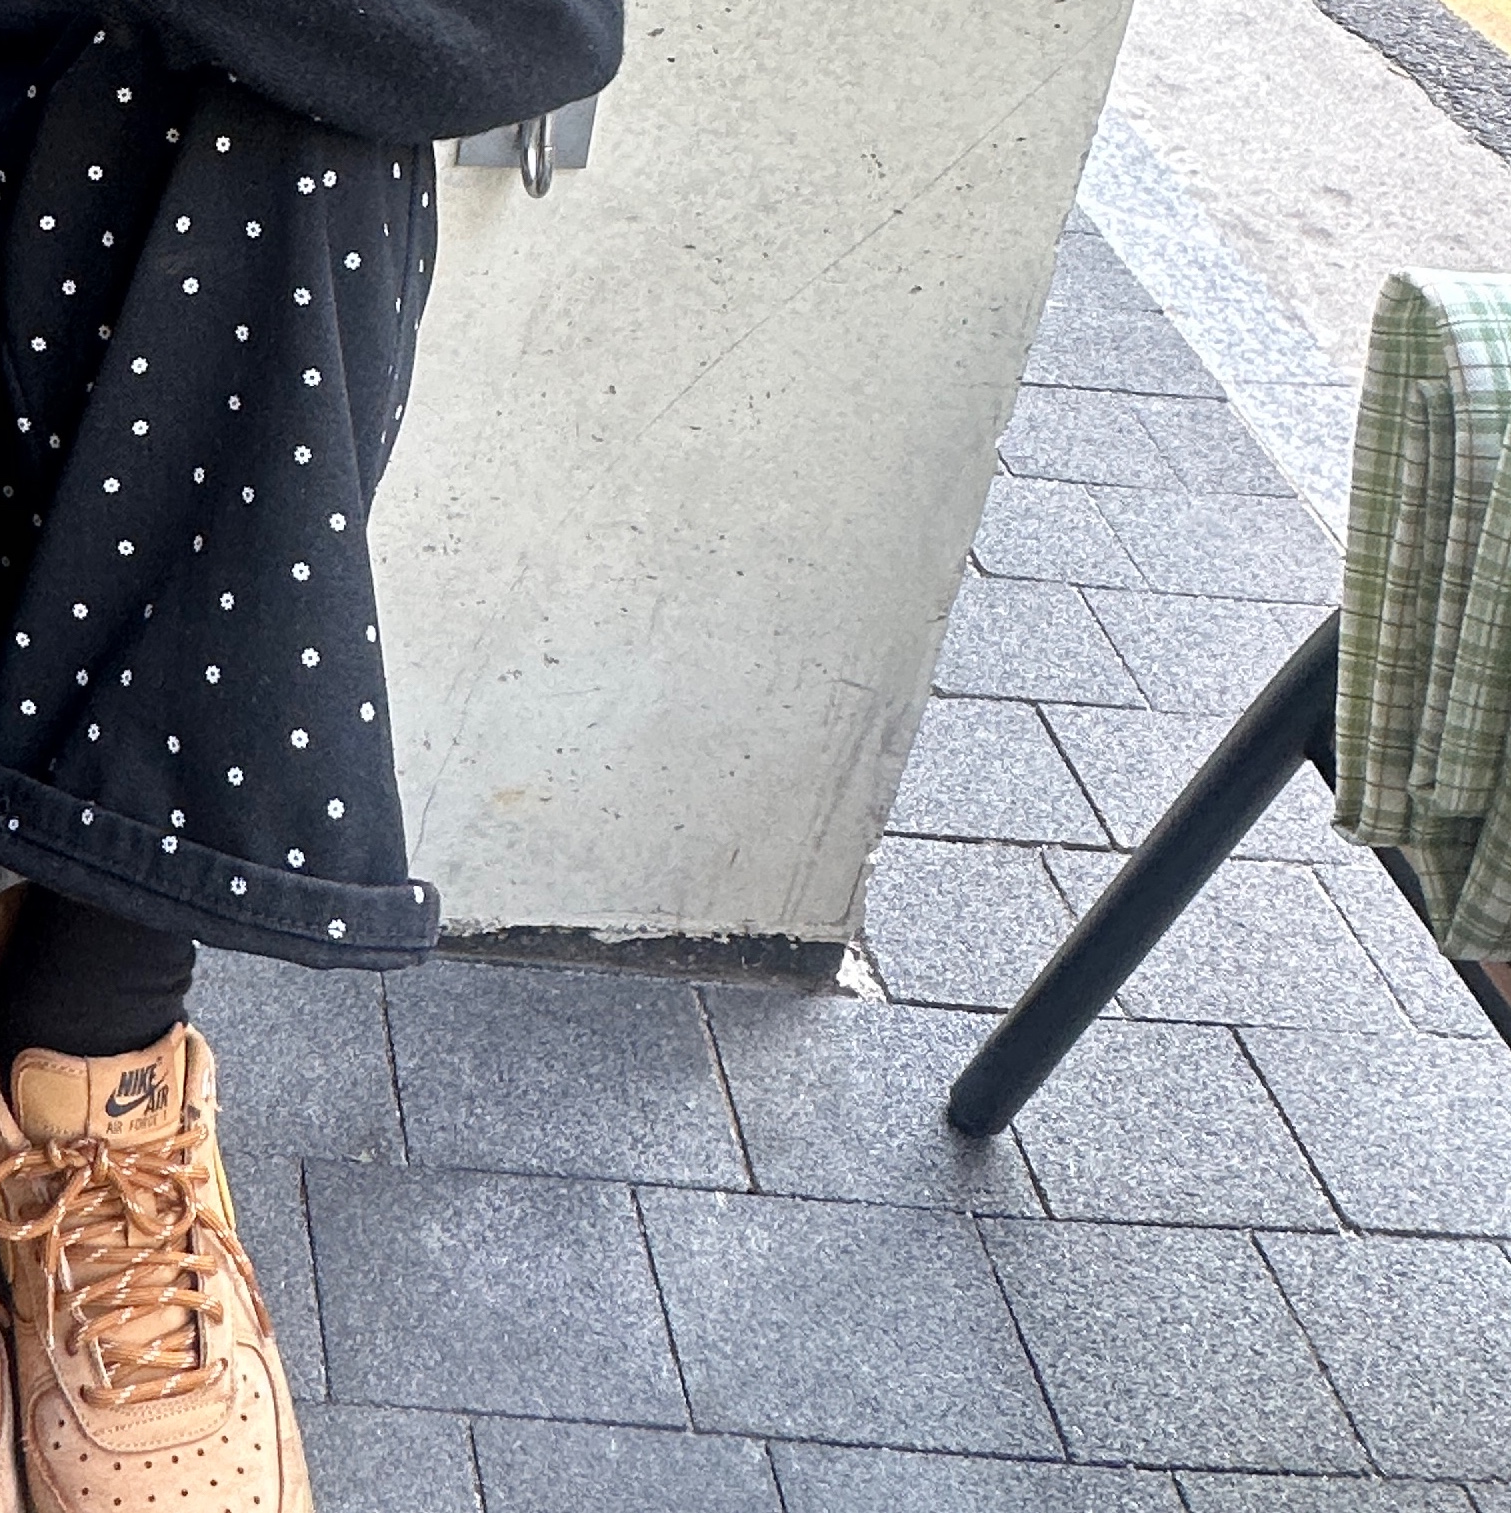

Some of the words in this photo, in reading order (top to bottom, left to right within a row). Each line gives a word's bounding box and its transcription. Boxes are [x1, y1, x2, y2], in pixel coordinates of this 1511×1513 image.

[116, 1063, 157, 1097] NIKE
[143, 1084, 169, 1116] AIR
[106, 1120, 124, 1135] AIR
[129, 1114, 158, 1131] FORCE
